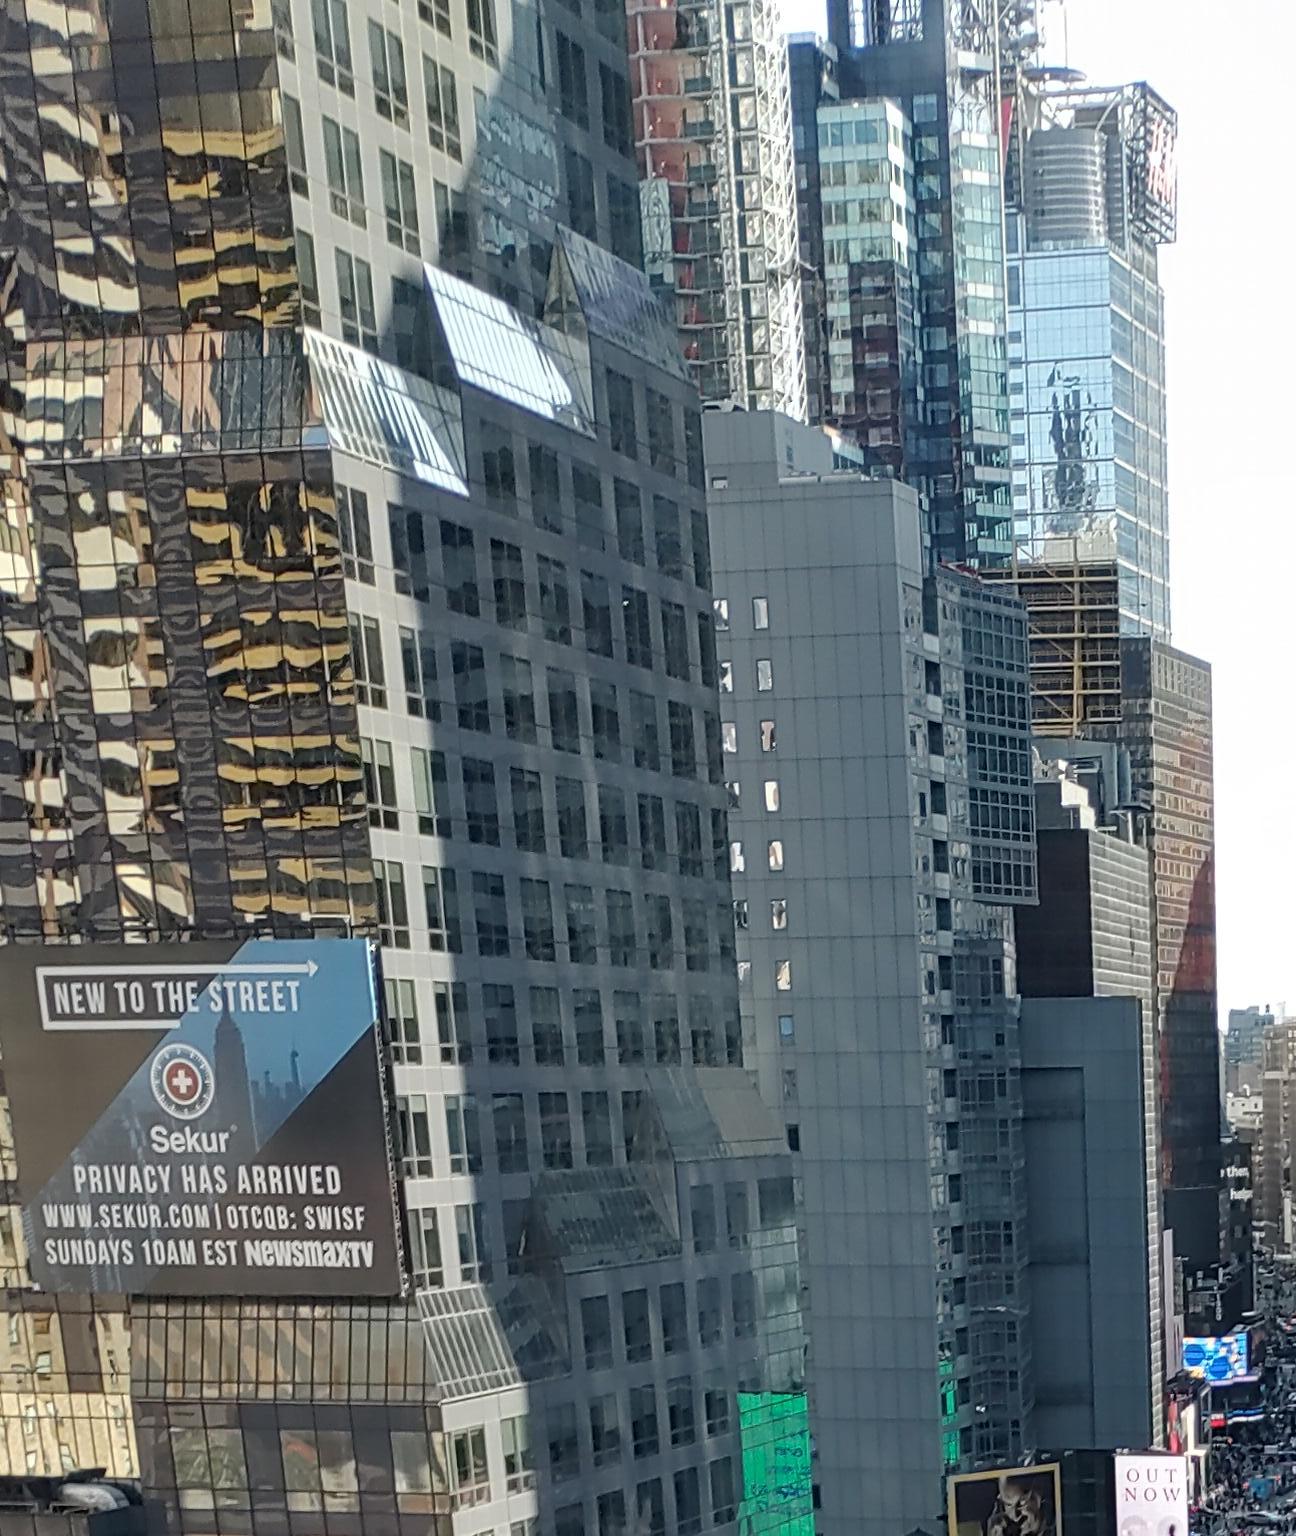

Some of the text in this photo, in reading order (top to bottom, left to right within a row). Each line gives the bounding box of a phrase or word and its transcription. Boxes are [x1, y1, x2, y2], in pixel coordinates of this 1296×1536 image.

[53, 979, 300, 1014] NEW TO THE STREET
[150, 1124, 230, 1153] Sekur
[73, 1164, 342, 1195] PRIVACY HAS ARRIVED
[42, 1203, 210, 1228] WWW.SEKUR.COM
[226, 1205, 297, 1231] OTCQB:
[303, 1206, 365, 1231] SWISF
[44, 1239, 134, 1265] SUNDAYS
[141, 1240, 197, 1266] 10AM
[203, 1240, 239, 1266] EST
[1126, 1467, 1178, 1483] OUT
[1124, 1487, 1181, 1502] NOW
